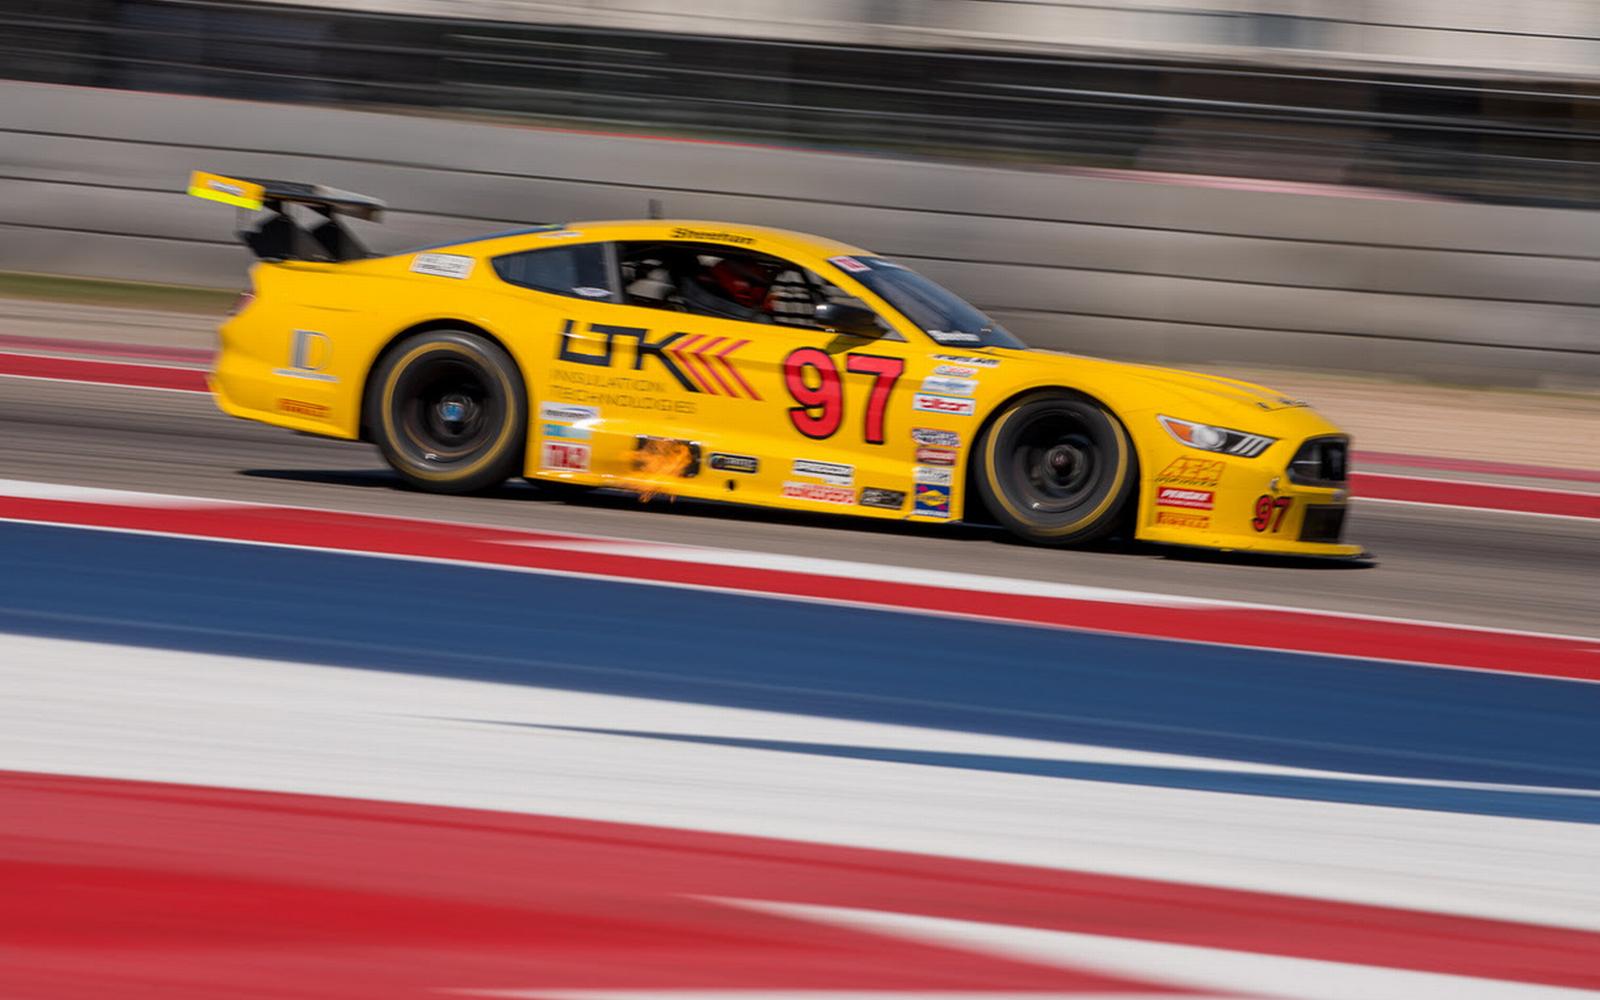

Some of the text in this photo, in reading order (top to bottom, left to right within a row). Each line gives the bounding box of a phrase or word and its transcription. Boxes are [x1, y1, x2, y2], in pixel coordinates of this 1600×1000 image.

[550, 369, 666, 393] INSULATION
[557, 319, 702, 394] LTK
[782, 346, 905, 445] 97
[1251, 494, 1294, 533] 97
